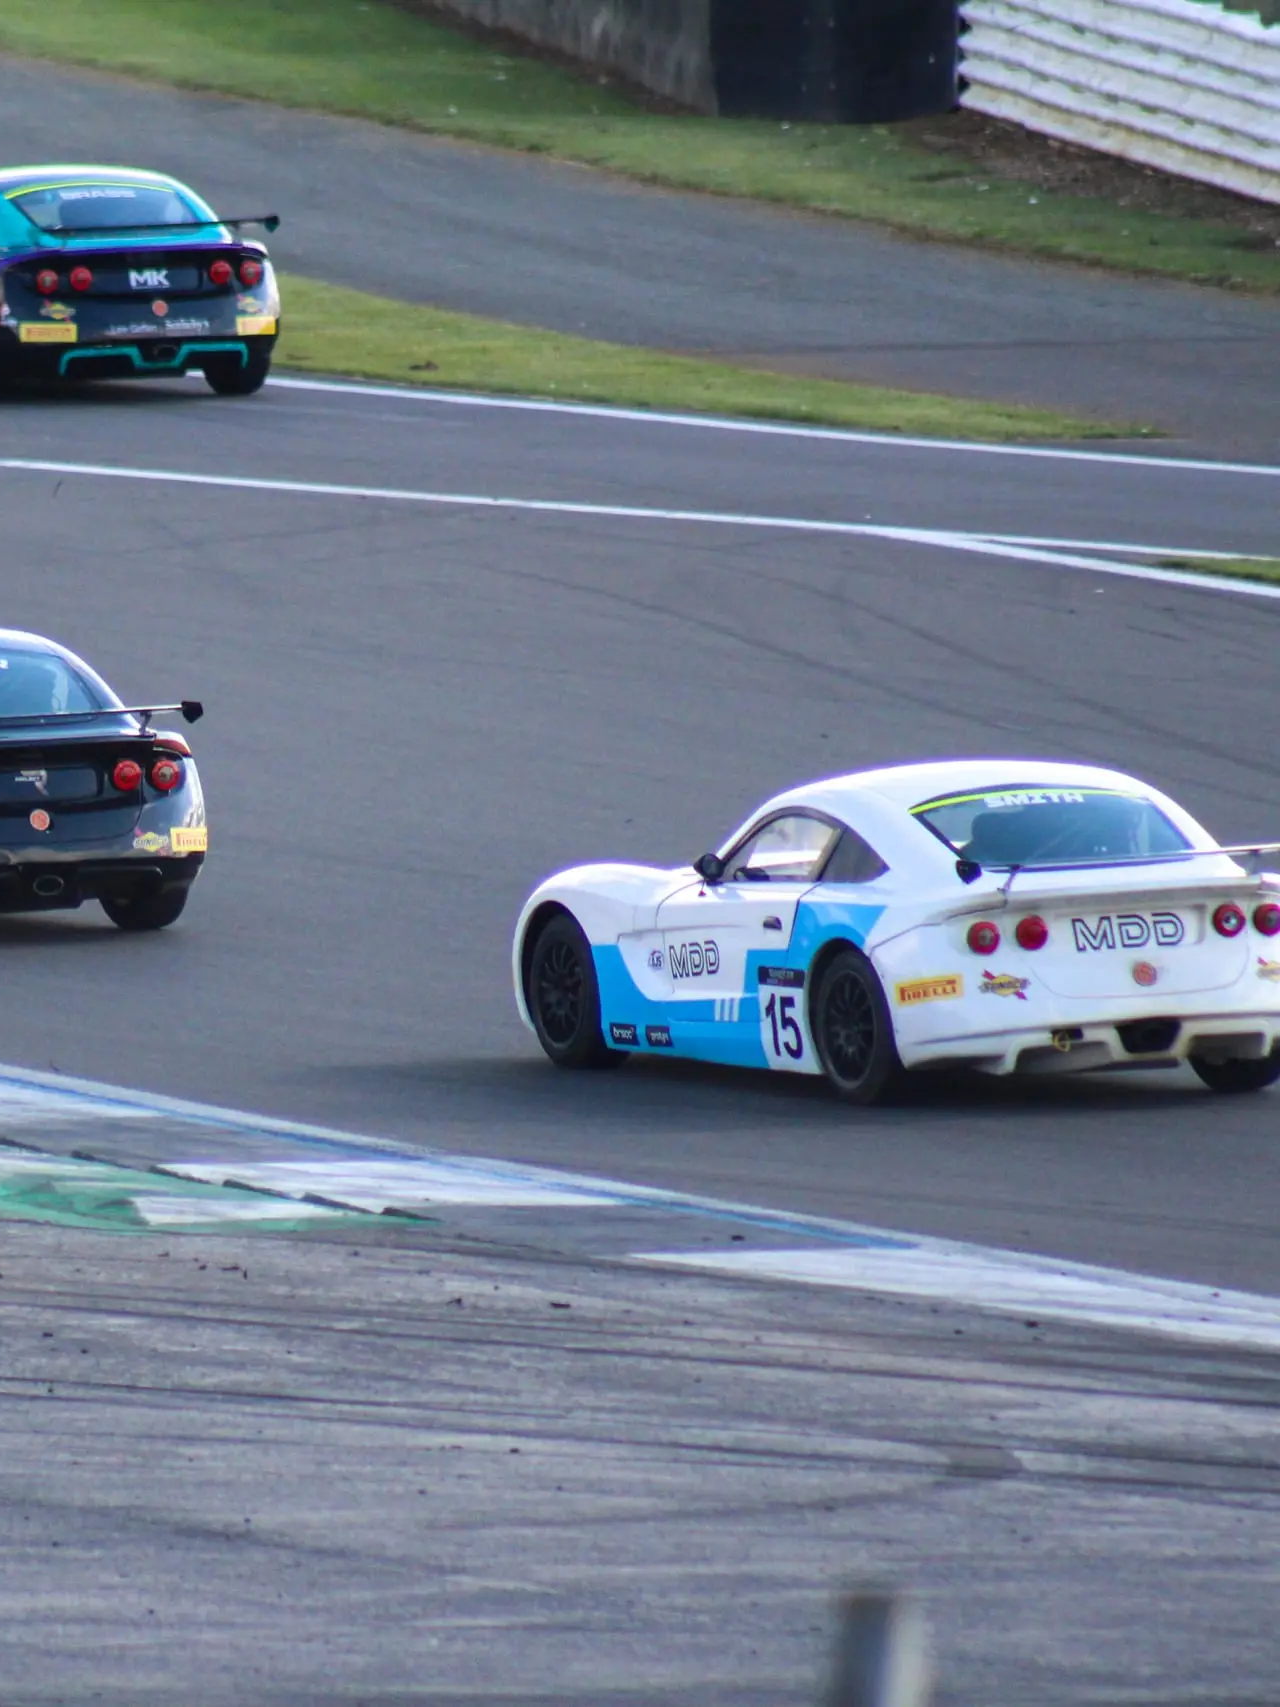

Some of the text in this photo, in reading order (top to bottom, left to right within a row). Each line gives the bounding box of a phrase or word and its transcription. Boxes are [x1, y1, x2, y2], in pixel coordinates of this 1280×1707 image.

[128, 268, 170, 289] MK
[1071, 912, 1184, 952] MDD
[669, 940, 720, 979] MDD
[900, 979, 957, 1003] PIRELLI
[765, 993, 803, 1060] 15
